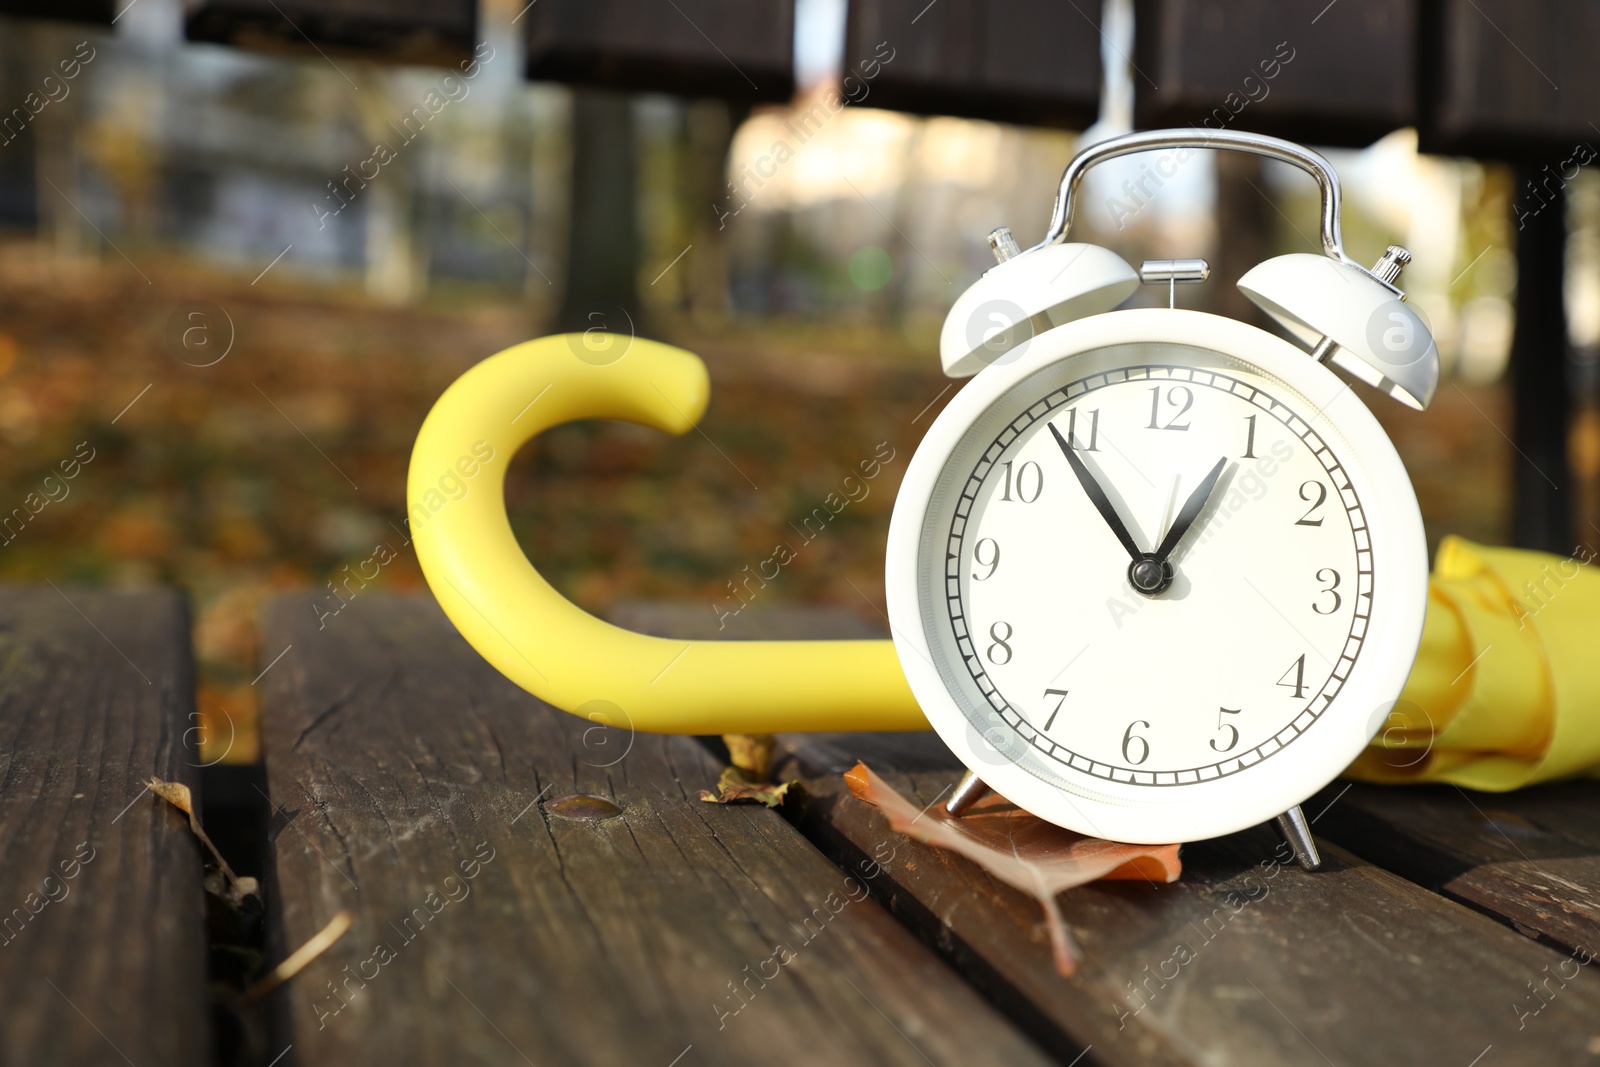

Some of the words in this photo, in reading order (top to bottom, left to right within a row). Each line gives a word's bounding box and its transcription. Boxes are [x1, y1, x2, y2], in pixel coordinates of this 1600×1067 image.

[1065, 407, 1102, 452] 11
[1144, 385, 1194, 431] 12
[1240, 414, 1259, 459] 1
[1000, 460, 1043, 503] 10
[1294, 480, 1327, 526] 2
[972, 537, 1000, 581] 9
[1312, 568, 1342, 614] 3
[986, 621, 1013, 665] 8
[1275, 653, 1309, 699] 4
[1042, 688, 1069, 731] 7
[1209, 706, 1242, 752] 5
[1121, 720, 1150, 765] 6
